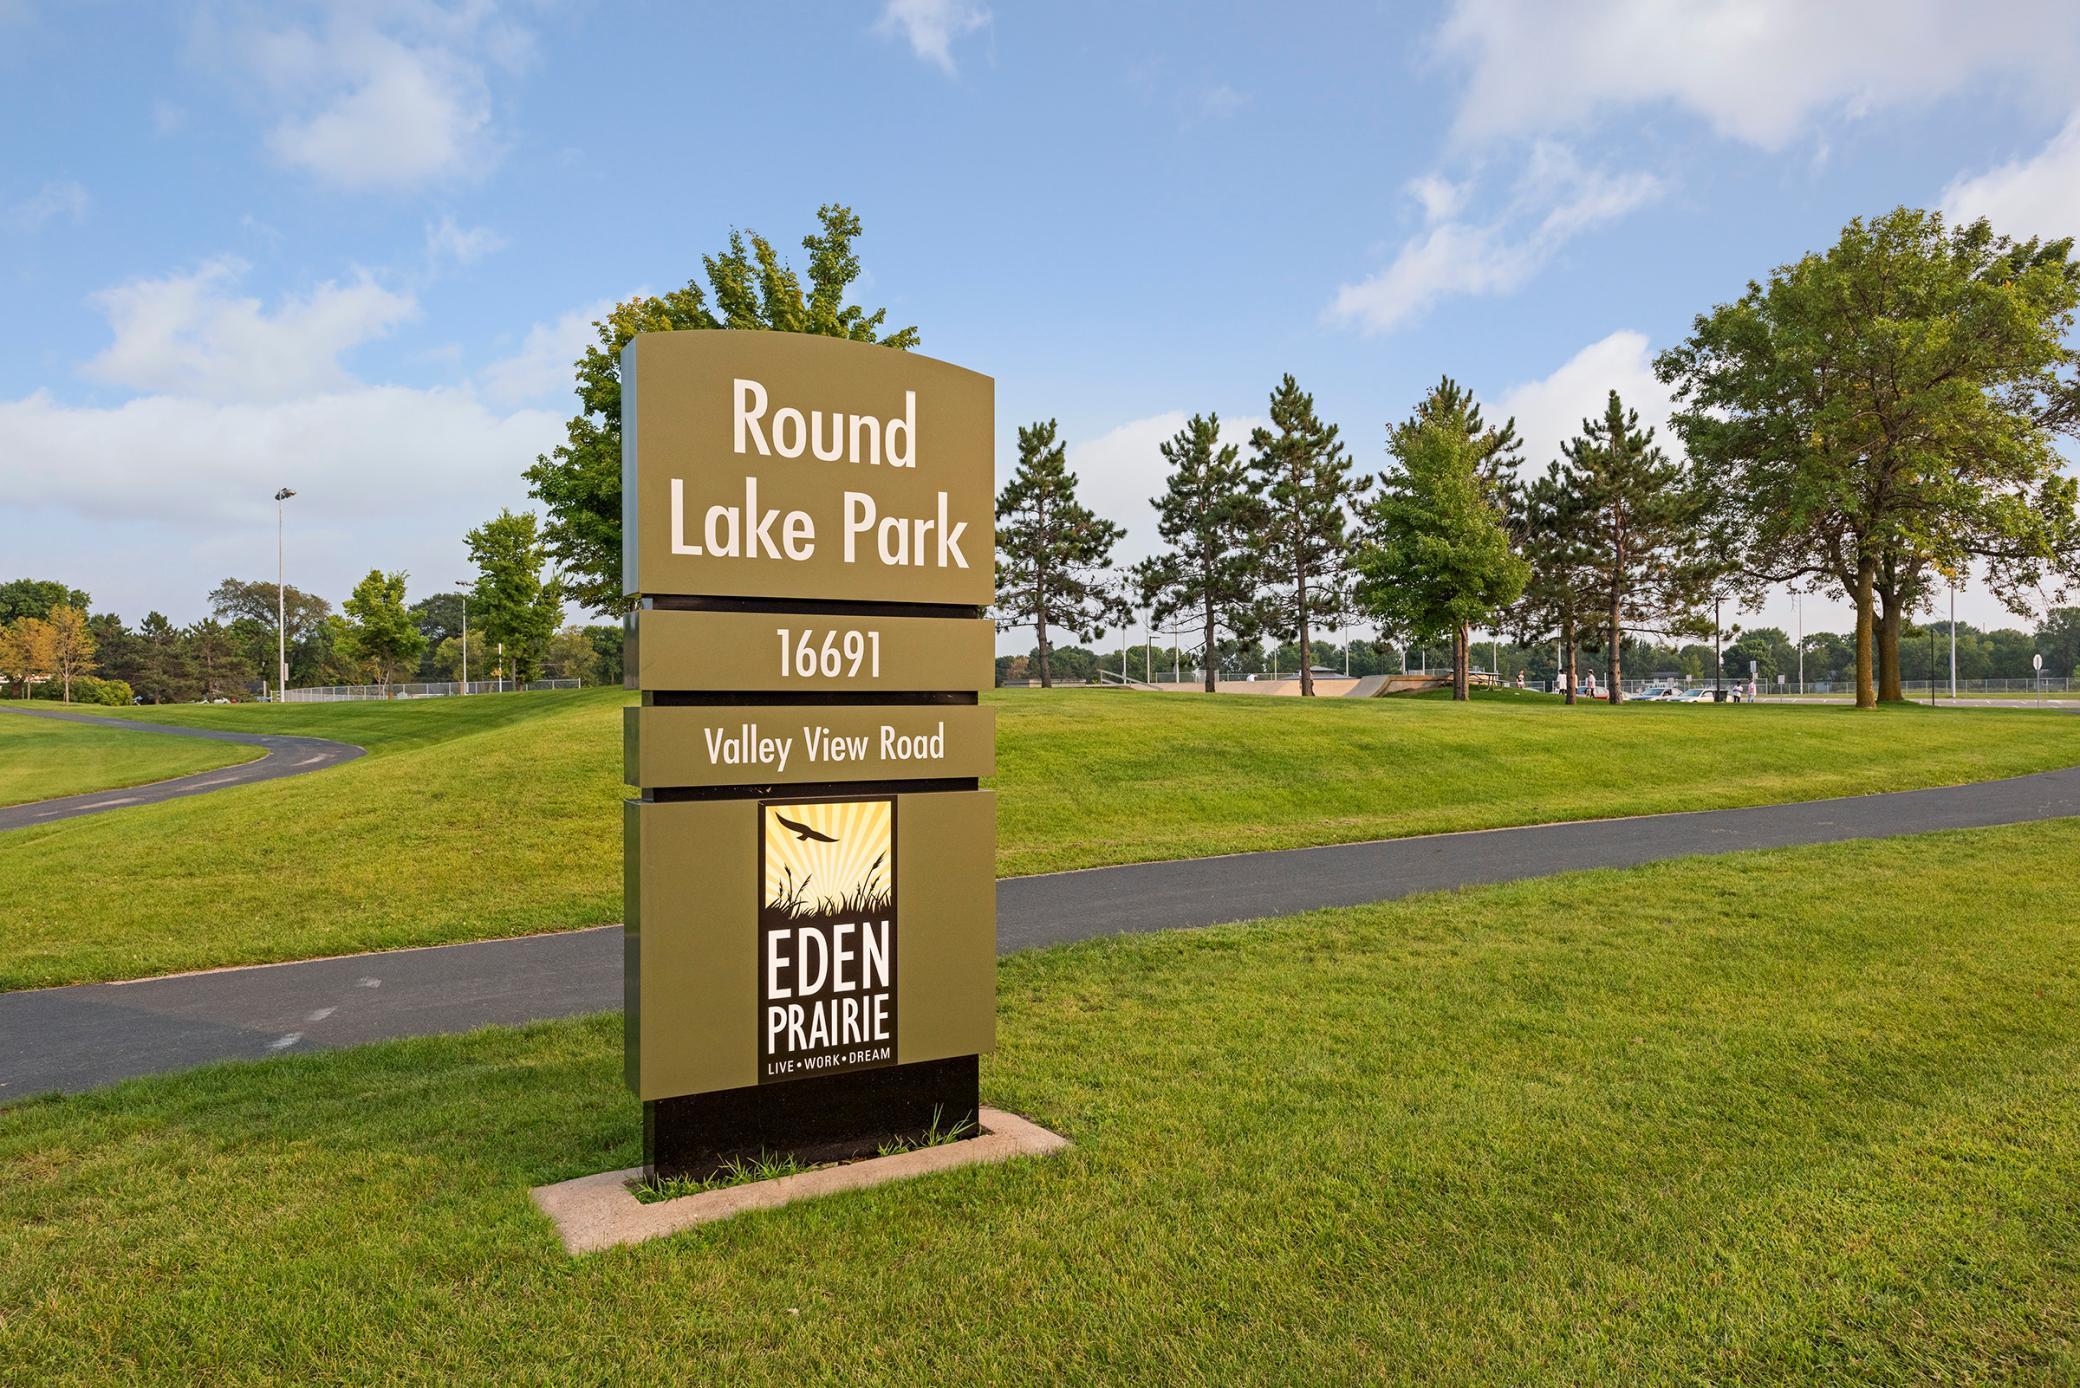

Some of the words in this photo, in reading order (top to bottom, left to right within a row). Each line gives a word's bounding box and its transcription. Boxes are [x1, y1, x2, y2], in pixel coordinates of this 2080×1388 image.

[733, 378, 916, 468] Round
[670, 476, 816, 561] Lake
[843, 491, 970, 568] Park
[776, 628, 880, 678] 16691
[704, 724, 793, 773] Valley
[803, 726, 869, 762] View
[880, 721, 945, 760] Road
[768, 920, 890, 1000] EDEN
[768, 993, 890, 1055] PRAIRIE
